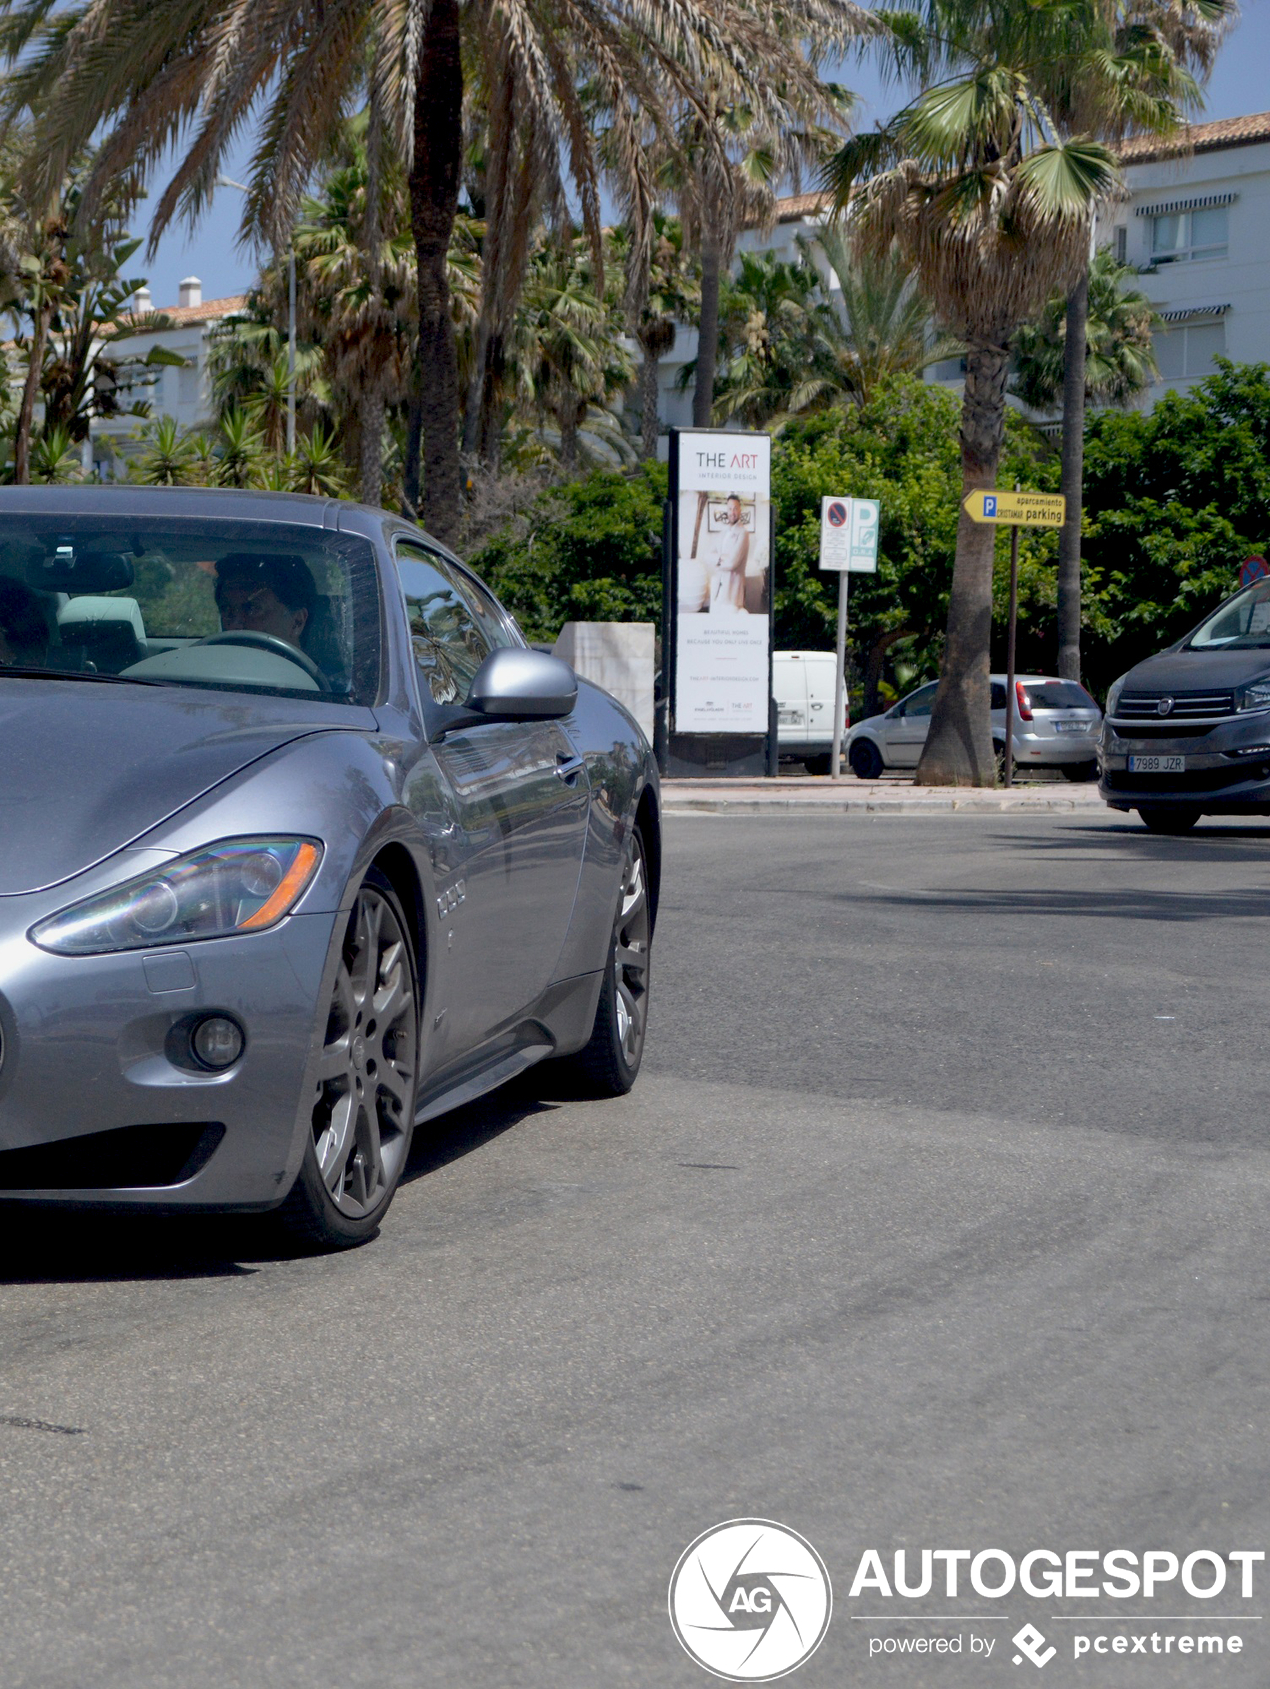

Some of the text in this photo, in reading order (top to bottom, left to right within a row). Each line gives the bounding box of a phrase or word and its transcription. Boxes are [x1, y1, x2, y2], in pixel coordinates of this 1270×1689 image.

[696, 452, 758, 468] THE ART
[985, 498, 994, 514] P
[1016, 496, 1062, 506] aparcamiento
[997, 508, 1062, 522] CRISTAMAR parking
[852, 500, 878, 547] P
[1136, 758, 1181, 770] 7989 JZR
